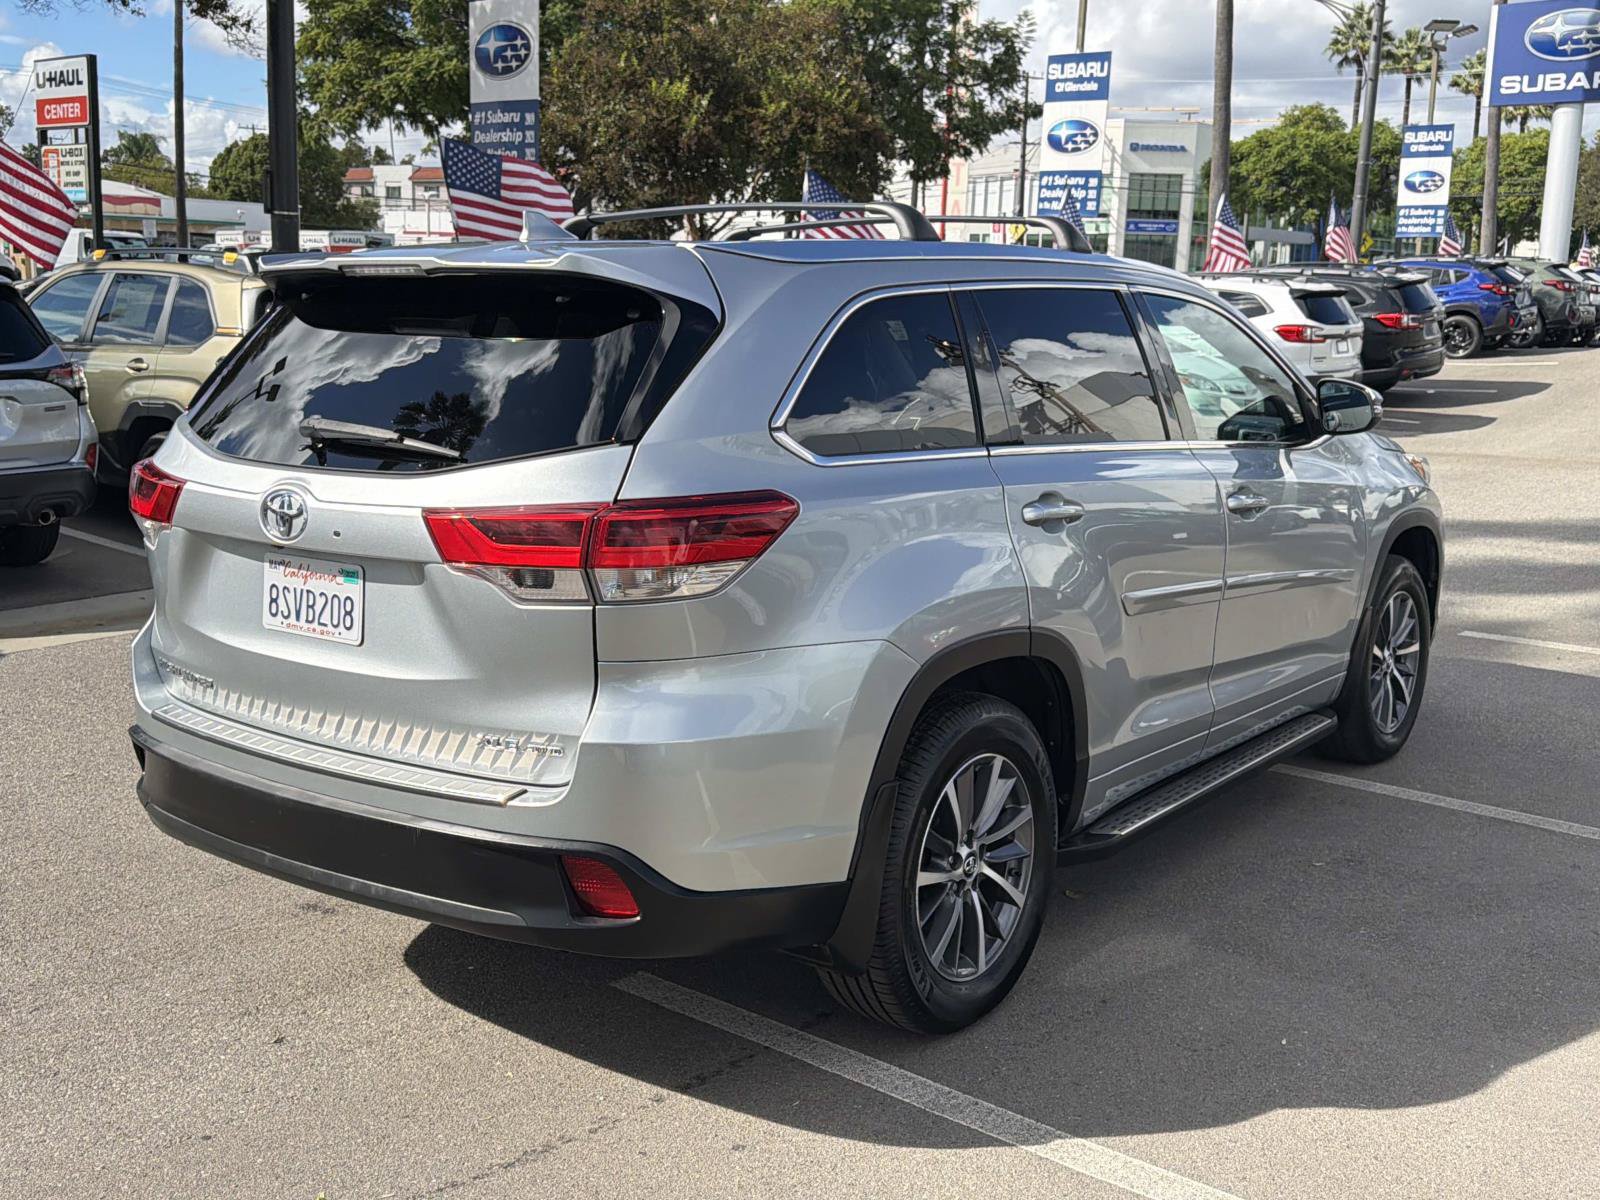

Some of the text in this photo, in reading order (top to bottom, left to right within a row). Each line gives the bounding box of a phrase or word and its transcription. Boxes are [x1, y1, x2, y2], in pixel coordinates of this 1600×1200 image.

[36, 68, 83, 89] U-HAUL
[1048, 61, 1109, 80] SUBARU
[1065, 80, 1098, 92] Glendale
[44, 102, 81, 120] CENTER
[474, 111, 485, 126] #1
[487, 109, 521, 124] Subaru
[474, 127, 523, 145] Dealership
[1404, 130, 1453, 143] SUBARU
[283, 560, 344, 586] California
[268, 583, 355, 632] 8SVB208
